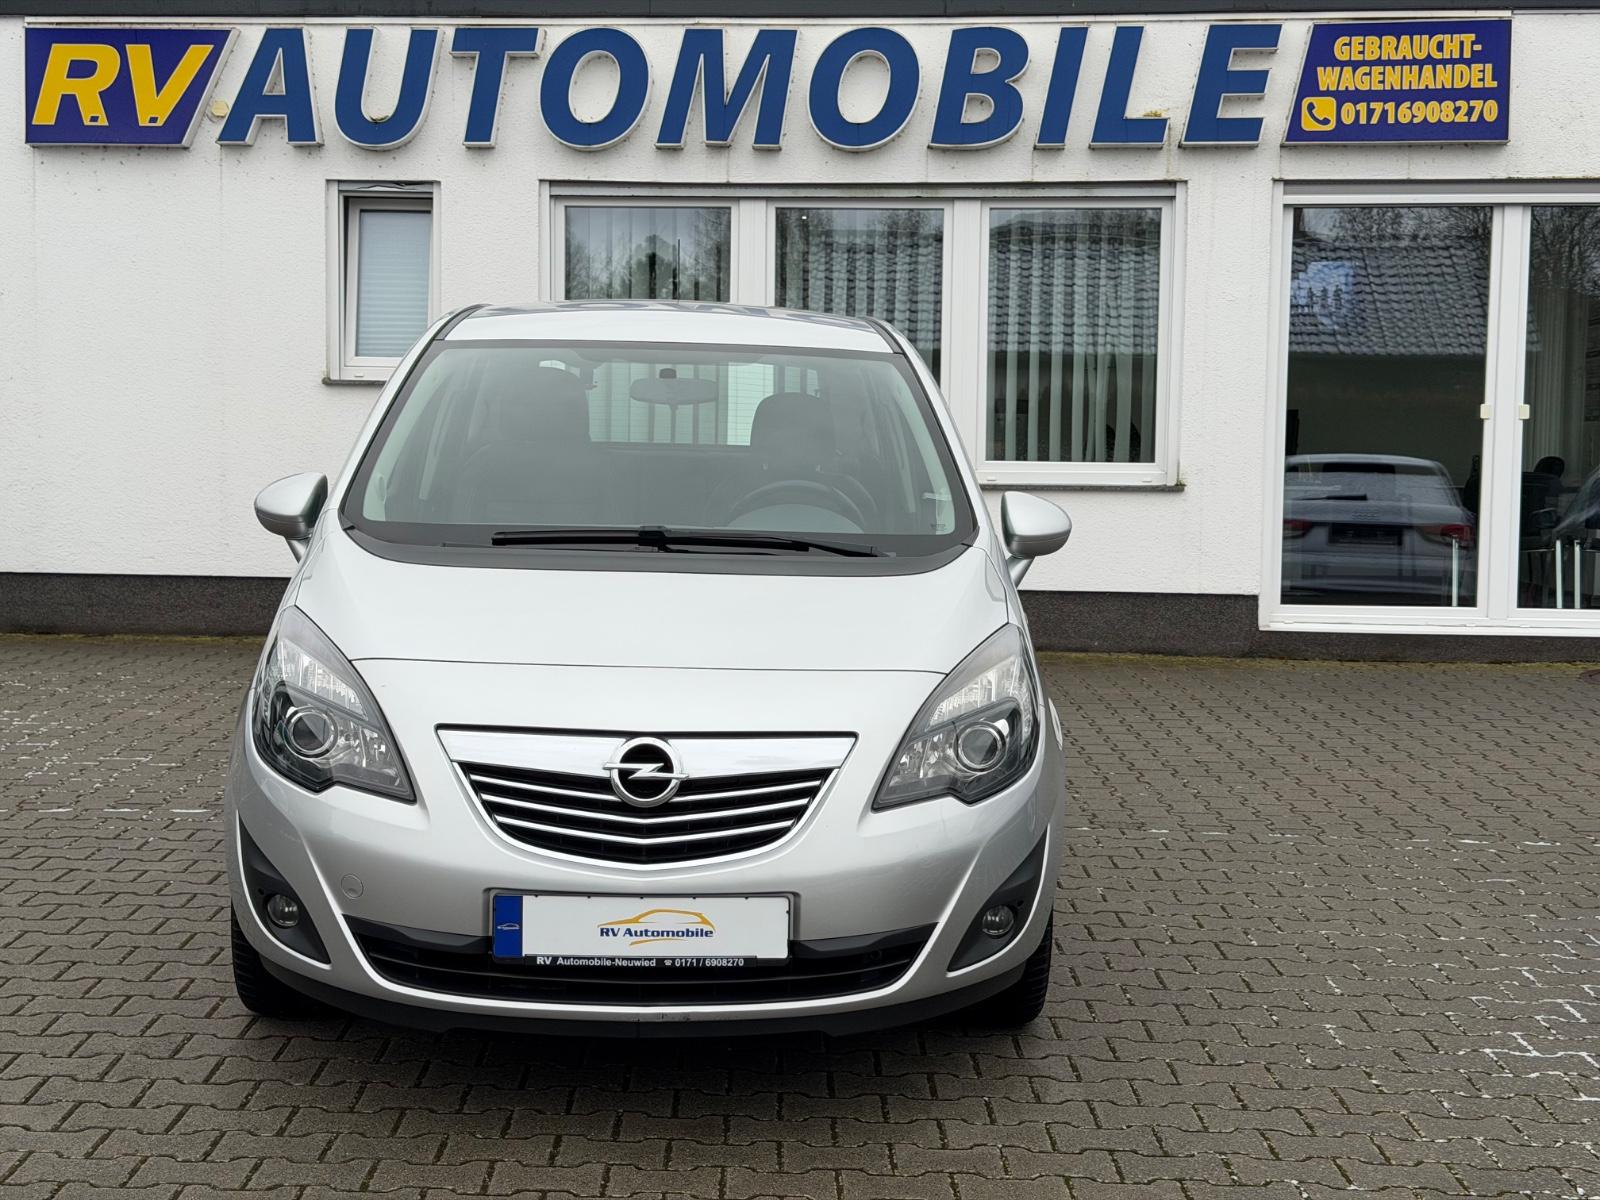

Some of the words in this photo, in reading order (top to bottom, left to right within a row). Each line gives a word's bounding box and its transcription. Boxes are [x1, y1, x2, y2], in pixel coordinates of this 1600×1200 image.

[1333, 33, 1482, 61] GEBRAUCHT-
[217, 24, 1281, 151] AUTOMOBILE
[1316, 63, 1498, 92] WAGENHANDEL
[1340, 99, 1498, 125] 01716908270
[599, 927, 620, 937] RV
[623, 927, 714, 938] Automobile
[536, 956, 552, 965] RV
[556, 957, 656, 967] Automobile-Neuwied
[674, 958, 697, 967] 0171
[705, 958, 745, 967] 6908270
